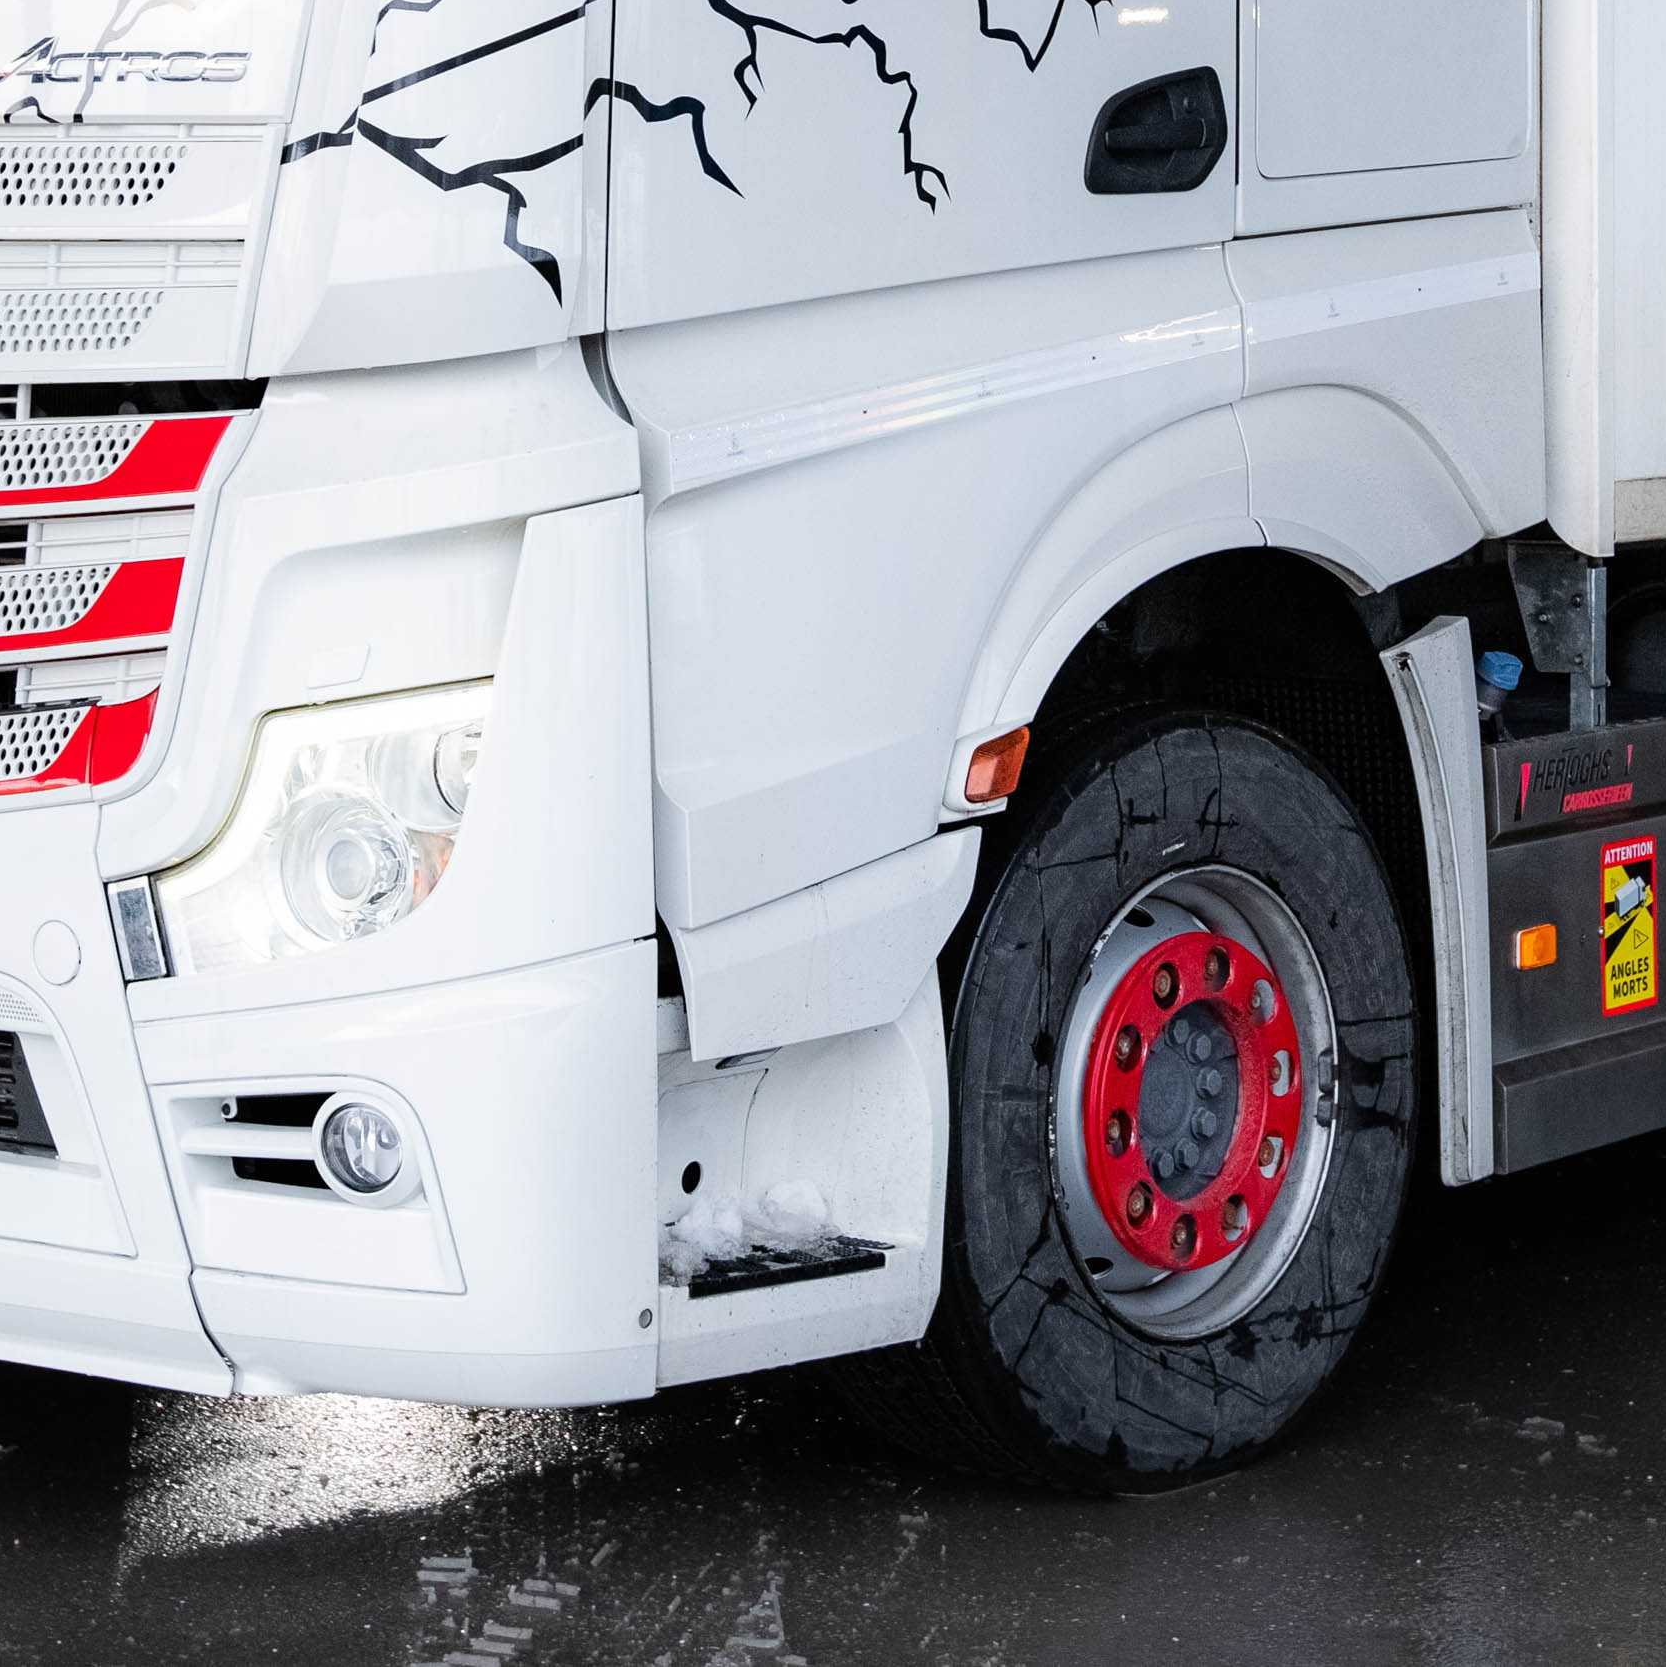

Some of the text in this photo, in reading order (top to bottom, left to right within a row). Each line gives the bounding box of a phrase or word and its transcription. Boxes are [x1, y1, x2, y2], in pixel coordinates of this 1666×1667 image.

[1604, 840, 1654, 865] ATTENTION
[1610, 955, 1650, 981] ANGLES
[1612, 975, 1649, 1000] MORTS
